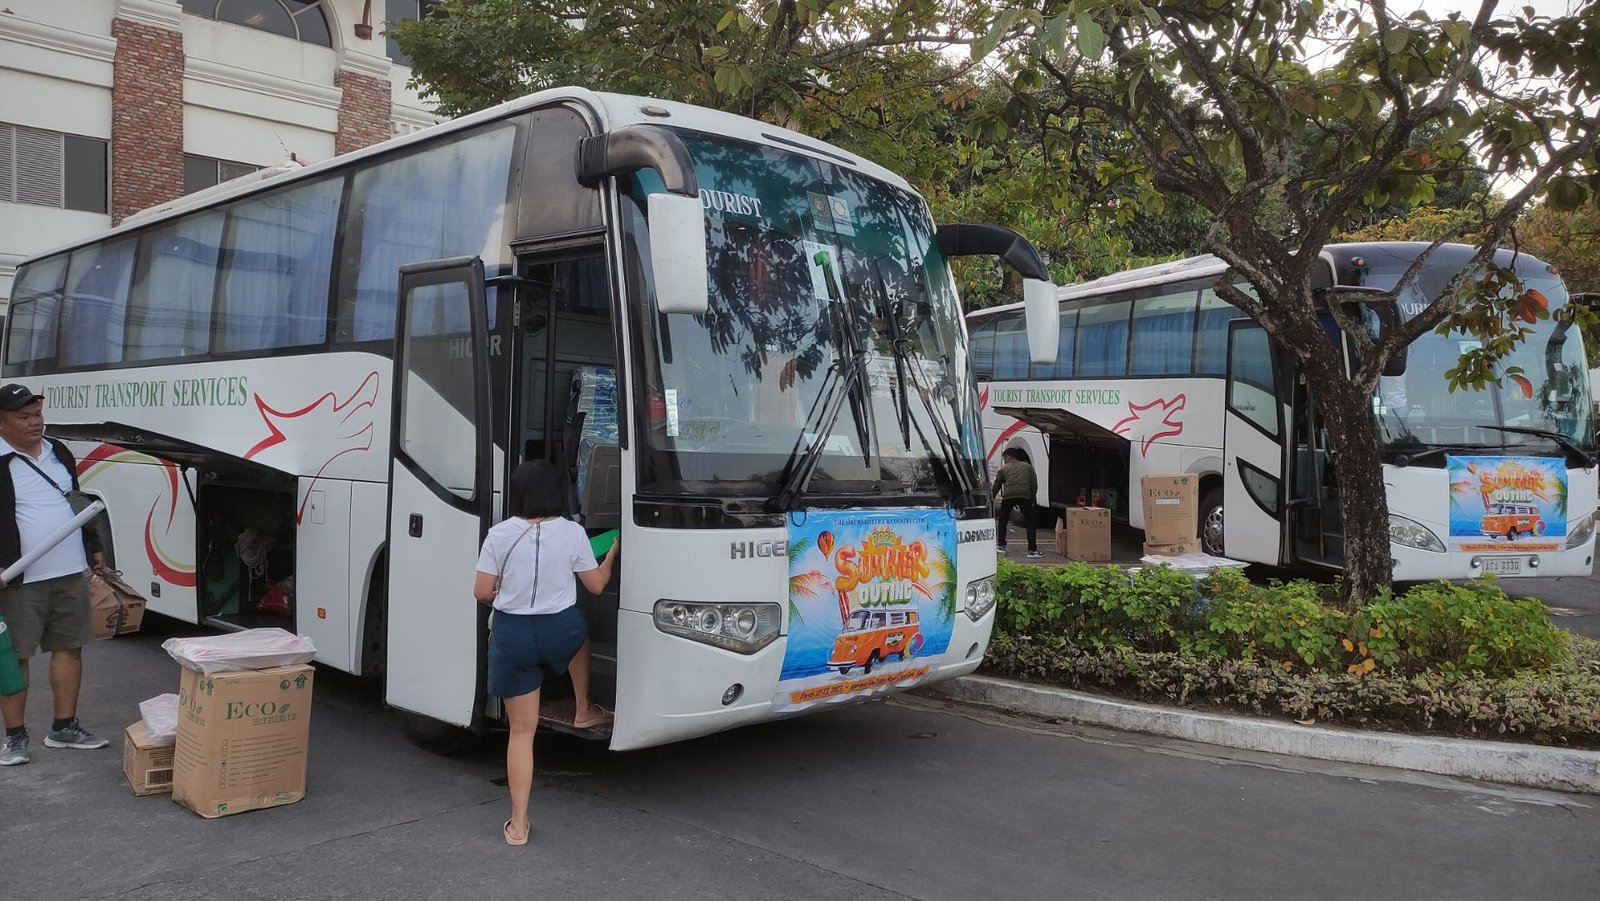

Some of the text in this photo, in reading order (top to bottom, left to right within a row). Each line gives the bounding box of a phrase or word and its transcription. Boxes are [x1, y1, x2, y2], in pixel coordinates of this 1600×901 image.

[698, 188, 762, 218] OURIST
[48, 376, 248, 409] TOURIST TRANSPORT SERVICES
[993, 389, 1120, 406] TOURIST TRANSPORT SERVICES
[1496, 489, 1533, 503] OUTING
[857, 582, 913, 608] OUTING
